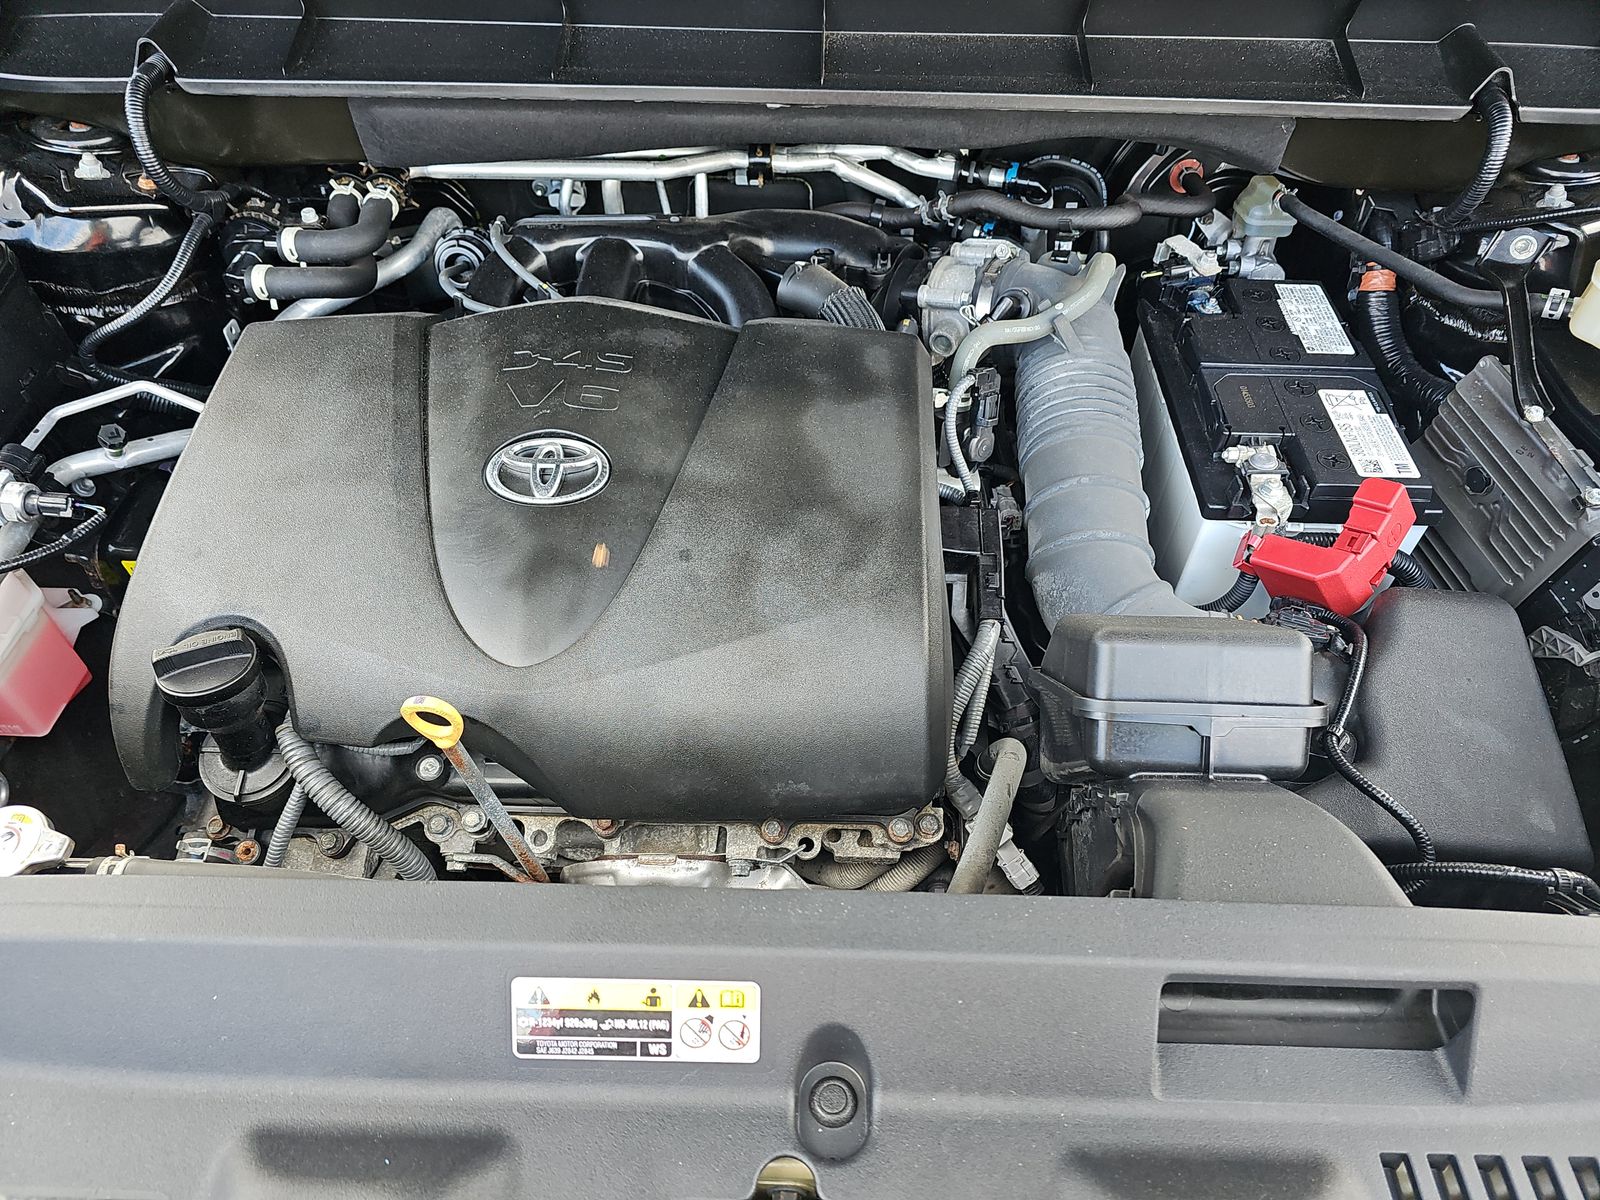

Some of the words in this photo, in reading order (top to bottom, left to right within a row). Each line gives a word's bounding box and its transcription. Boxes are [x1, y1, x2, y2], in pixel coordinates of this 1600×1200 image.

[505, 379, 621, 412] V6
[536, 1040, 557, 1048] TOYOTA
[558, 1040, 578, 1048] MOTOR
[579, 1041, 618, 1049] CORPORATION
[648, 1043, 668, 1056] WS
